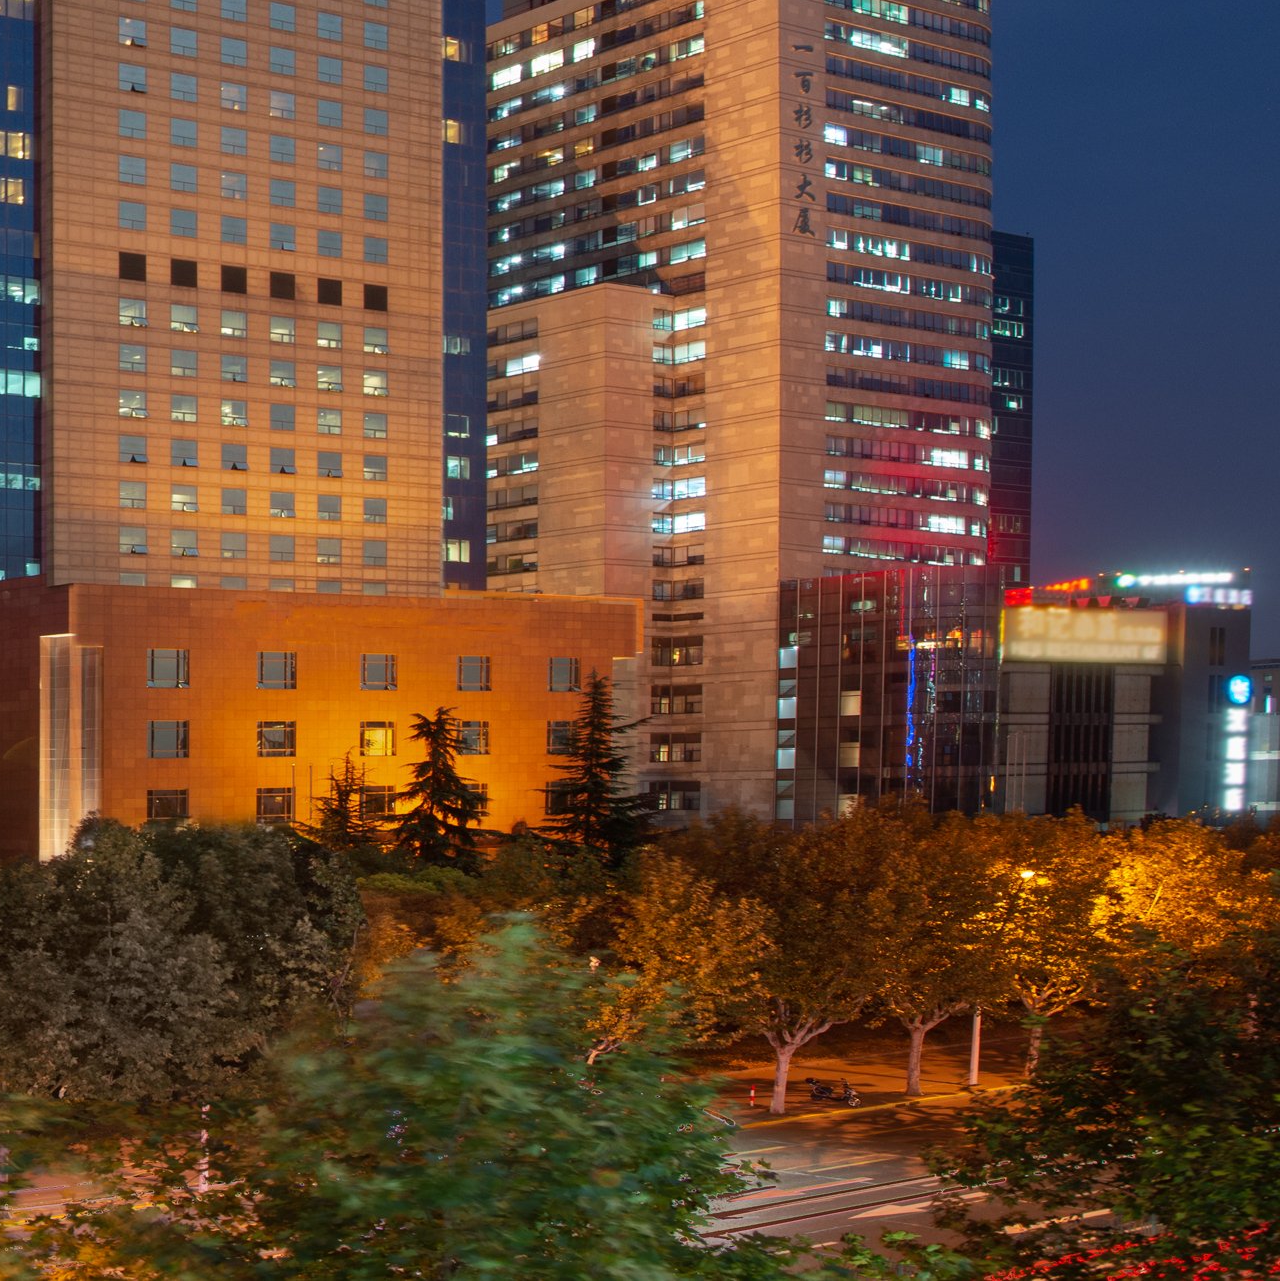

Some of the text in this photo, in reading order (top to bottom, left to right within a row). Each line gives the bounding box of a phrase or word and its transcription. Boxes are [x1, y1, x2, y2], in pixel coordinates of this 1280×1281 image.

[791, 44, 816, 238] 一百杉杉大厦
